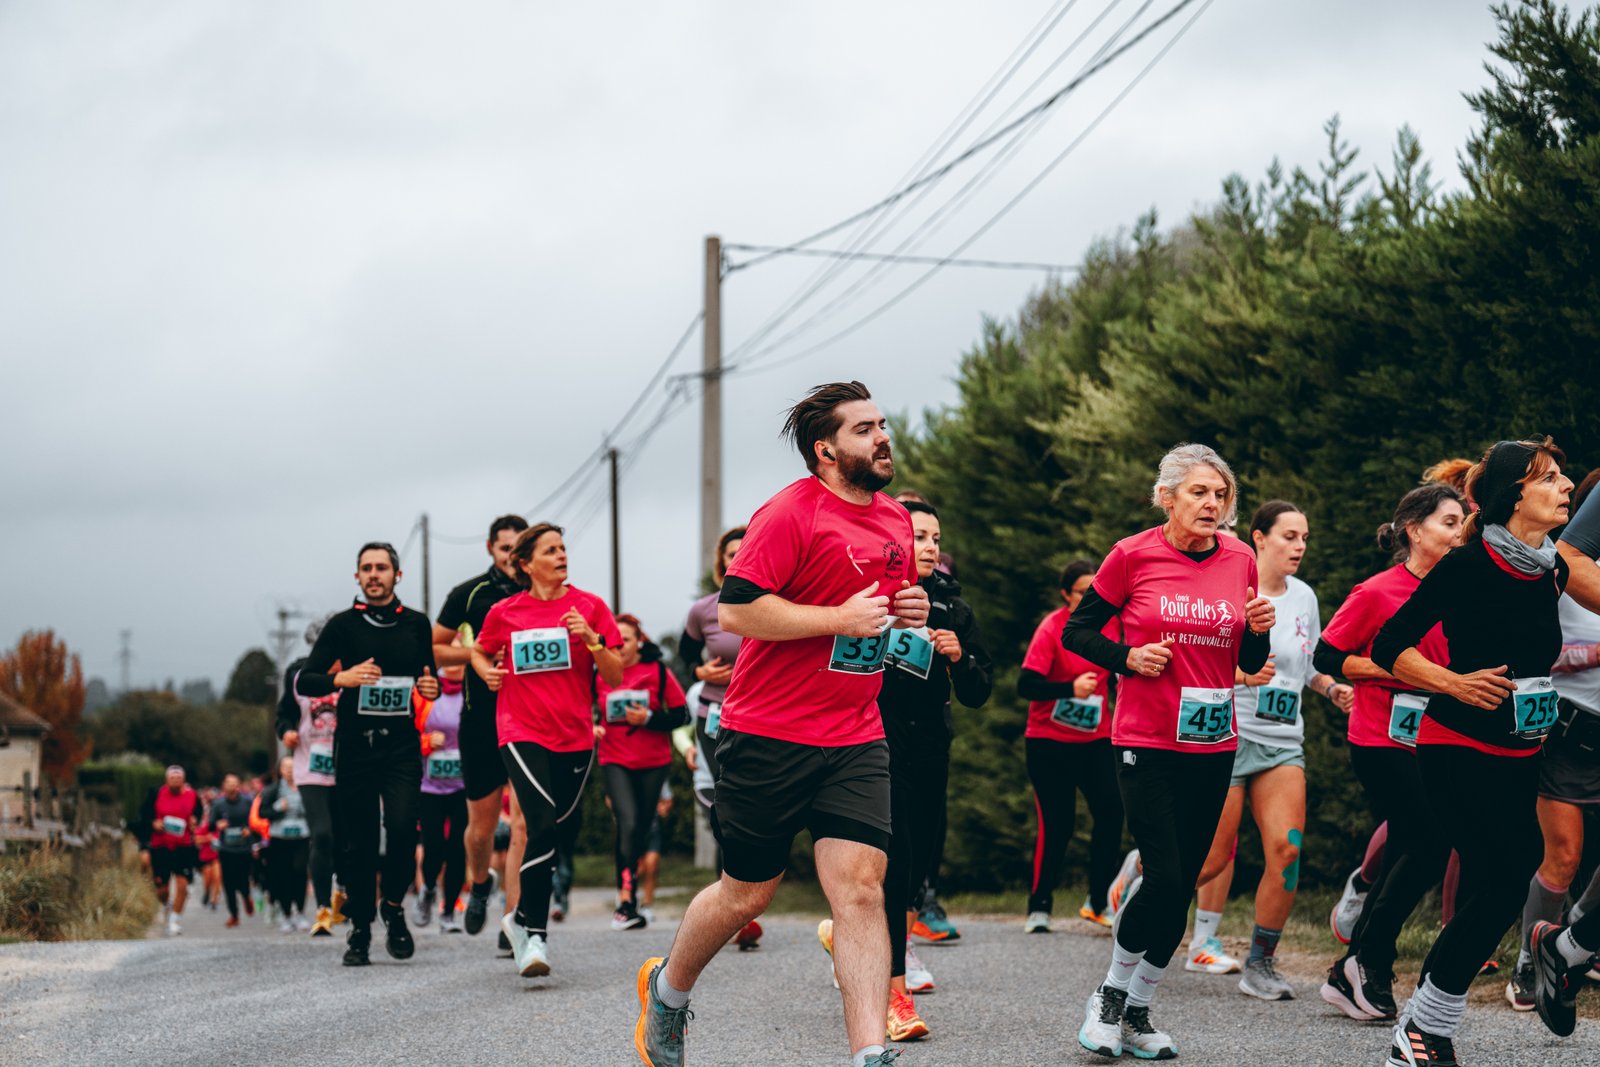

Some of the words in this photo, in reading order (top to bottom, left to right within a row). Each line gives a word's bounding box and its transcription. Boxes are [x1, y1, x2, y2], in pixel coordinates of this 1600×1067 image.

[1160, 595, 1190, 617] Pour
[1191, 598, 1217, 620] elles
[1160, 631, 1176, 643] LES
[1178, 632, 1234, 648] RETROUVAILLES
[1218, 626, 1232, 637] 2022
[520, 641, 561, 663] 189
[368, 688, 403, 707] 565
[1266, 690, 1297, 716] 167
[1060, 700, 1096, 722] 244
[1188, 704, 1229, 732] 453
[1523, 694, 1555, 727] 259
[1398, 711, 1419, 735] 4
